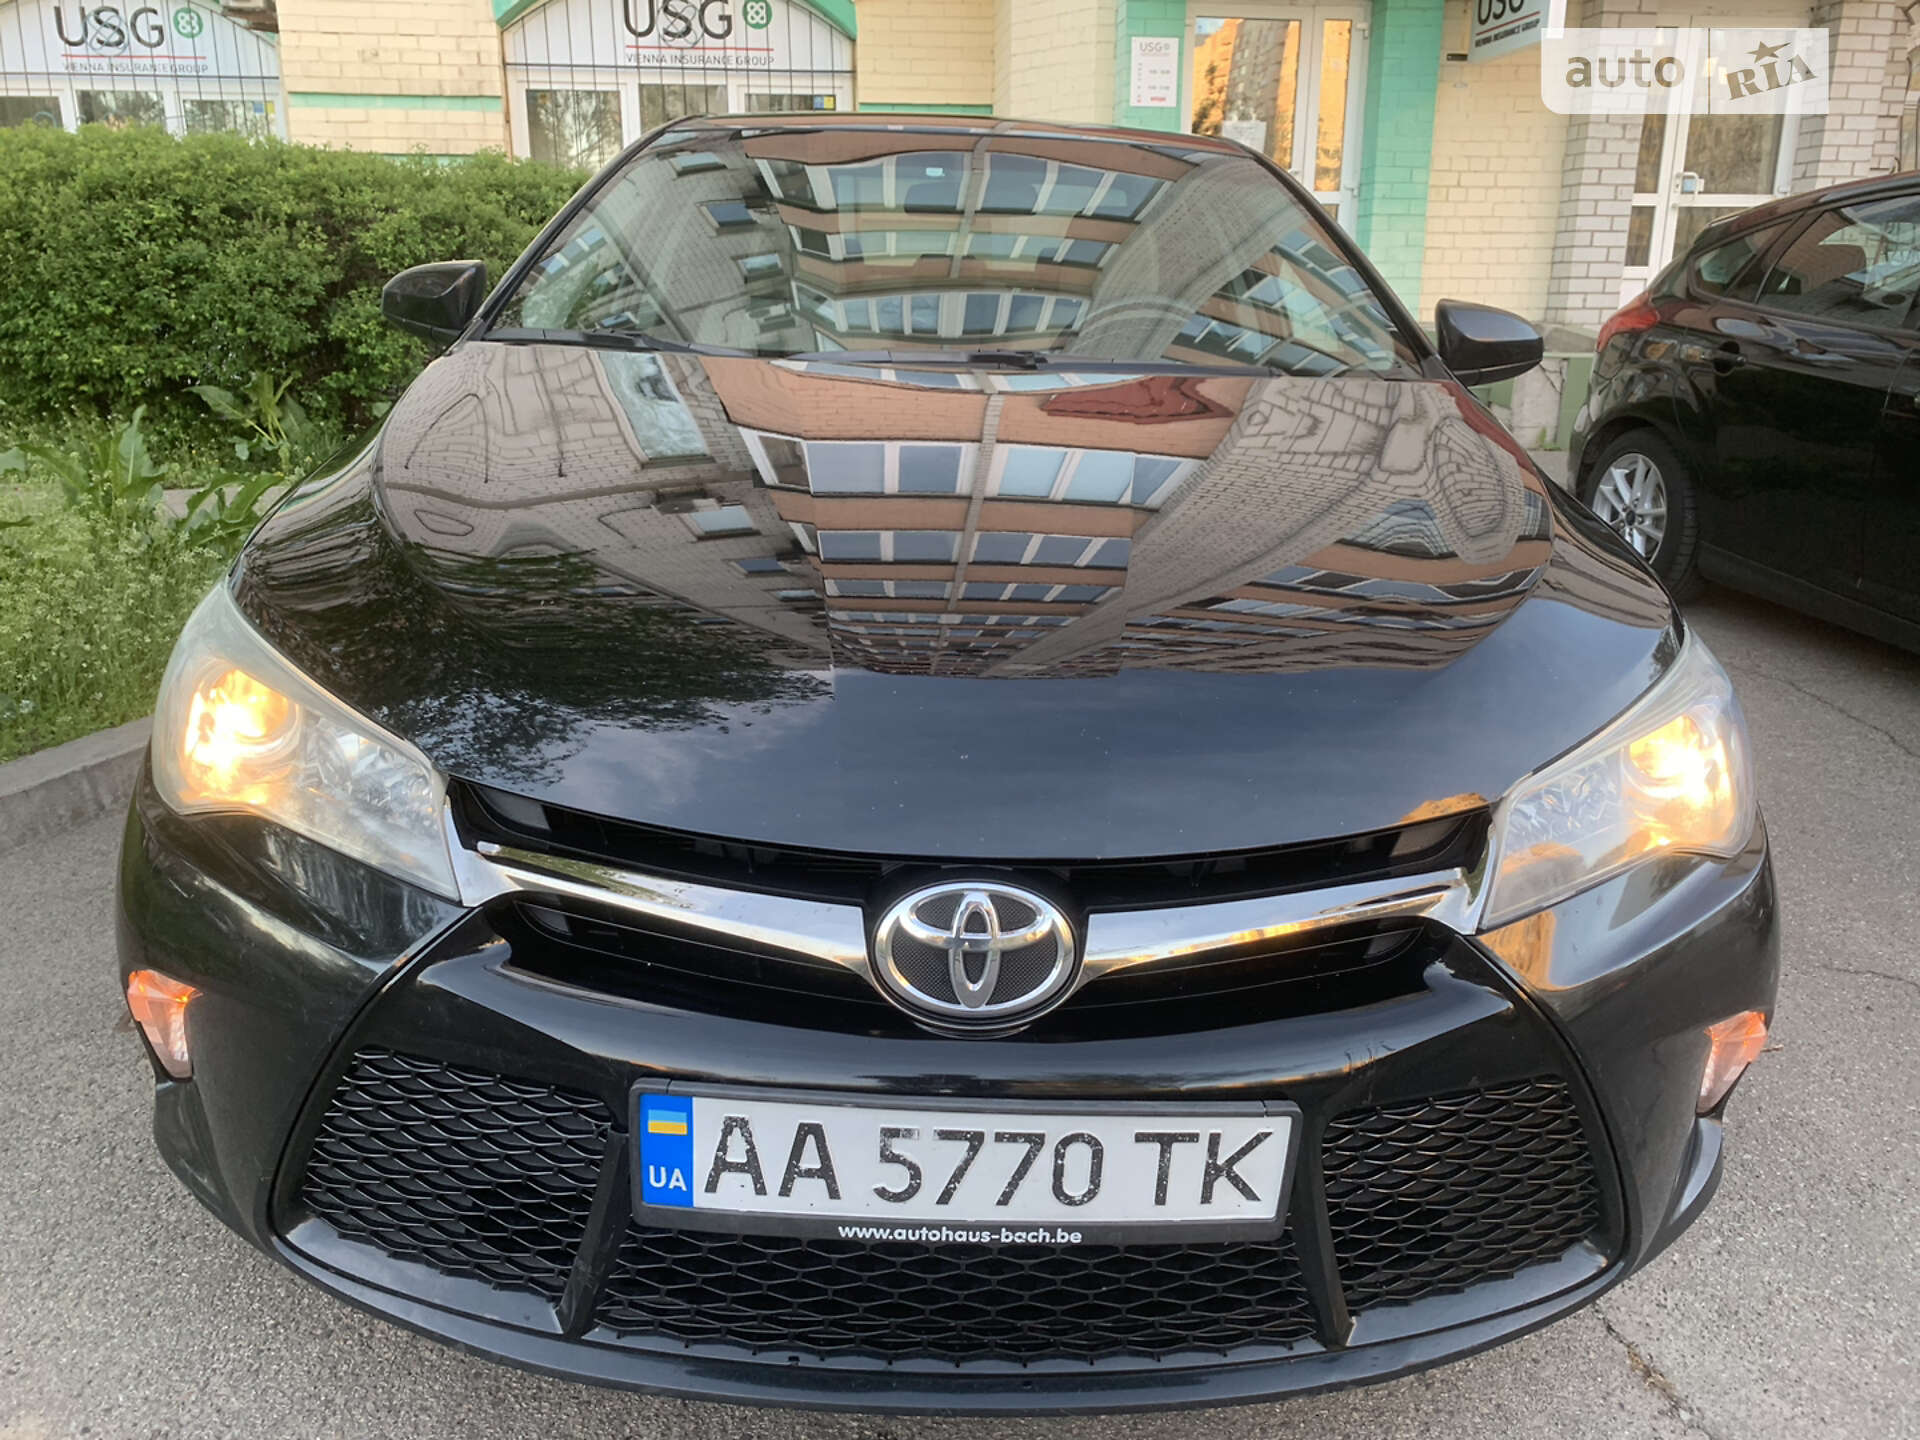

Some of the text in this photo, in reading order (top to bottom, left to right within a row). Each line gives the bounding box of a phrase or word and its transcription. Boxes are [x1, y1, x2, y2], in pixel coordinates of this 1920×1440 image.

[54, 6, 165, 48] USG
[624, 0, 732, 39] USG
[626, 54, 774, 65] VIENNA INSURANCE GROUP
[704, 1115, 1273, 1207] AA 5770 TK
[649, 1165, 687, 1191] UA
[838, 1225, 1082, 1244] www.autohaus-bach.be
